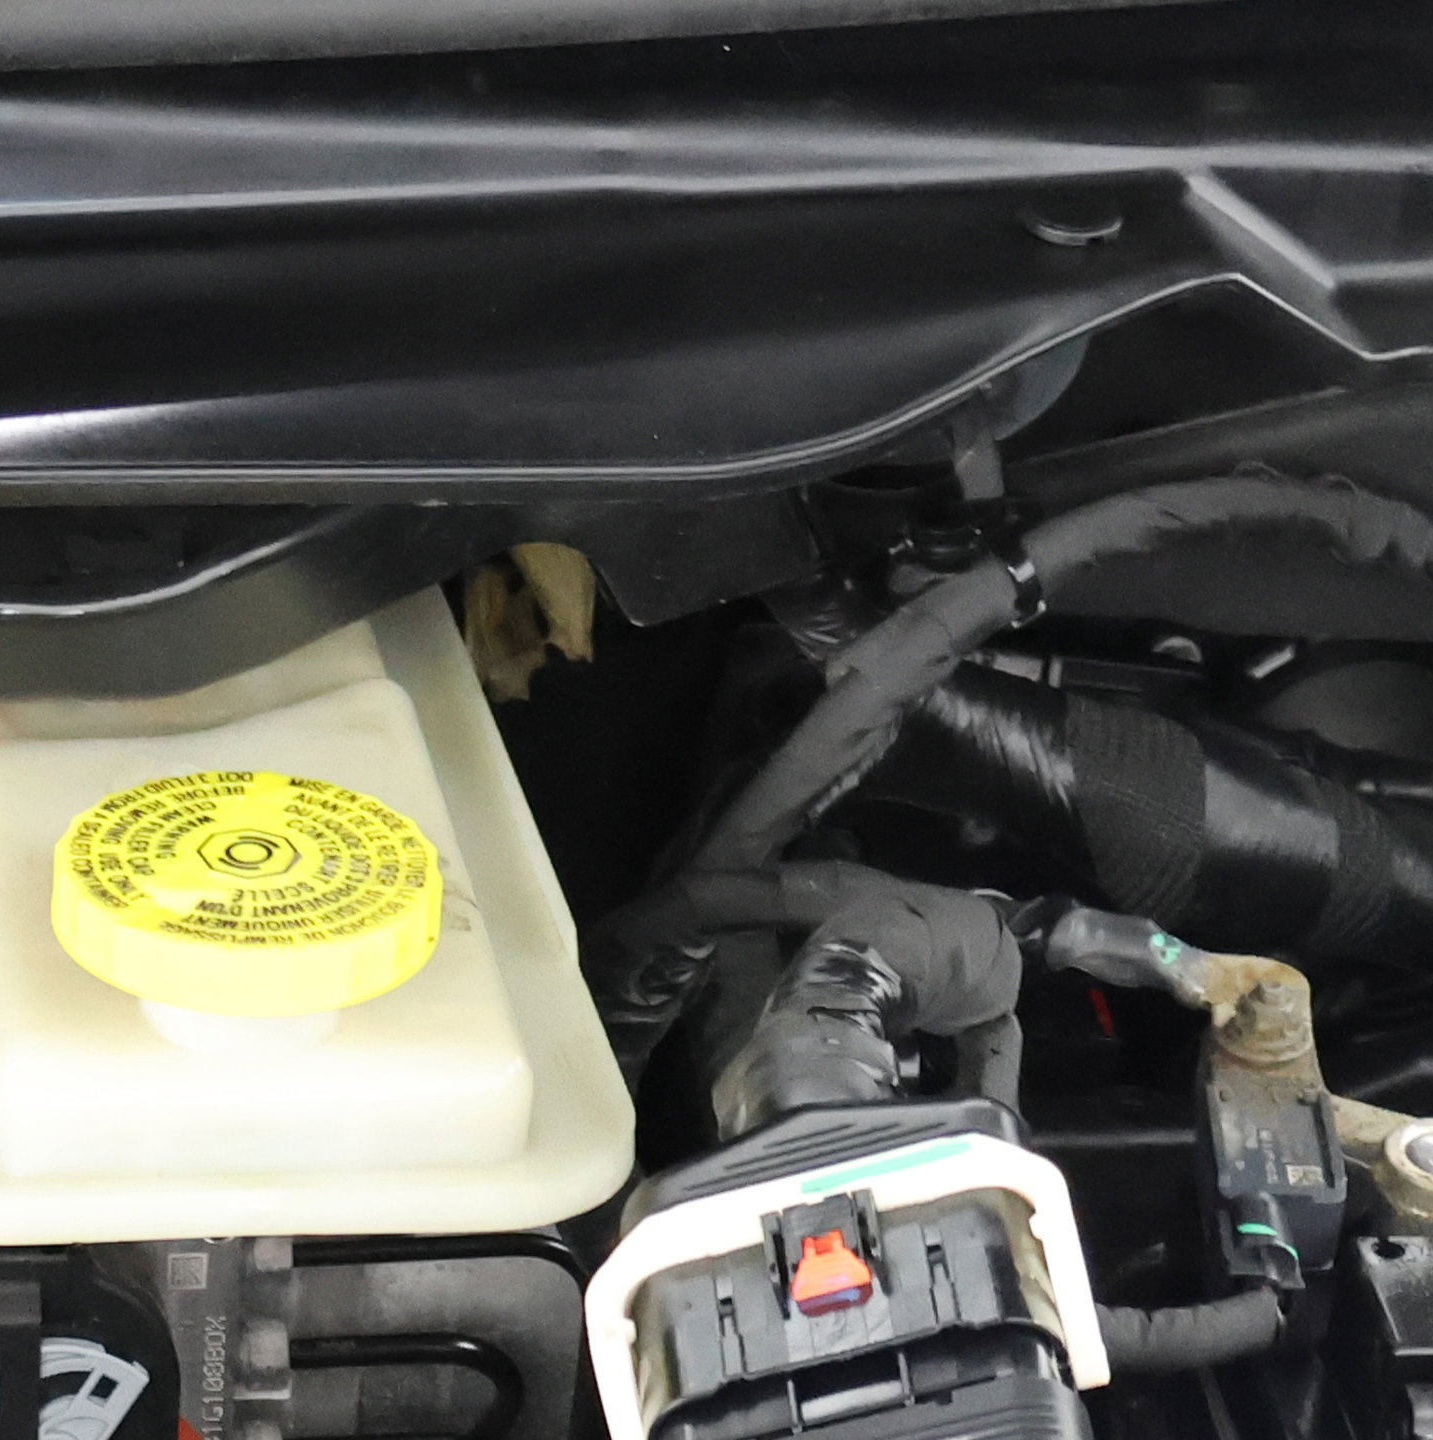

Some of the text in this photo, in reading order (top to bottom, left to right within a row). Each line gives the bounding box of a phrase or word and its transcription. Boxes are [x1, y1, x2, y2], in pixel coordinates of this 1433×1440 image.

[143, 774, 195, 795] FLUID
[170, 785, 246, 803] BEFORE
[99, 789, 146, 814] FROM
[158, 801, 217, 822] CLEAN
[155, 815, 217, 859] WARNING
